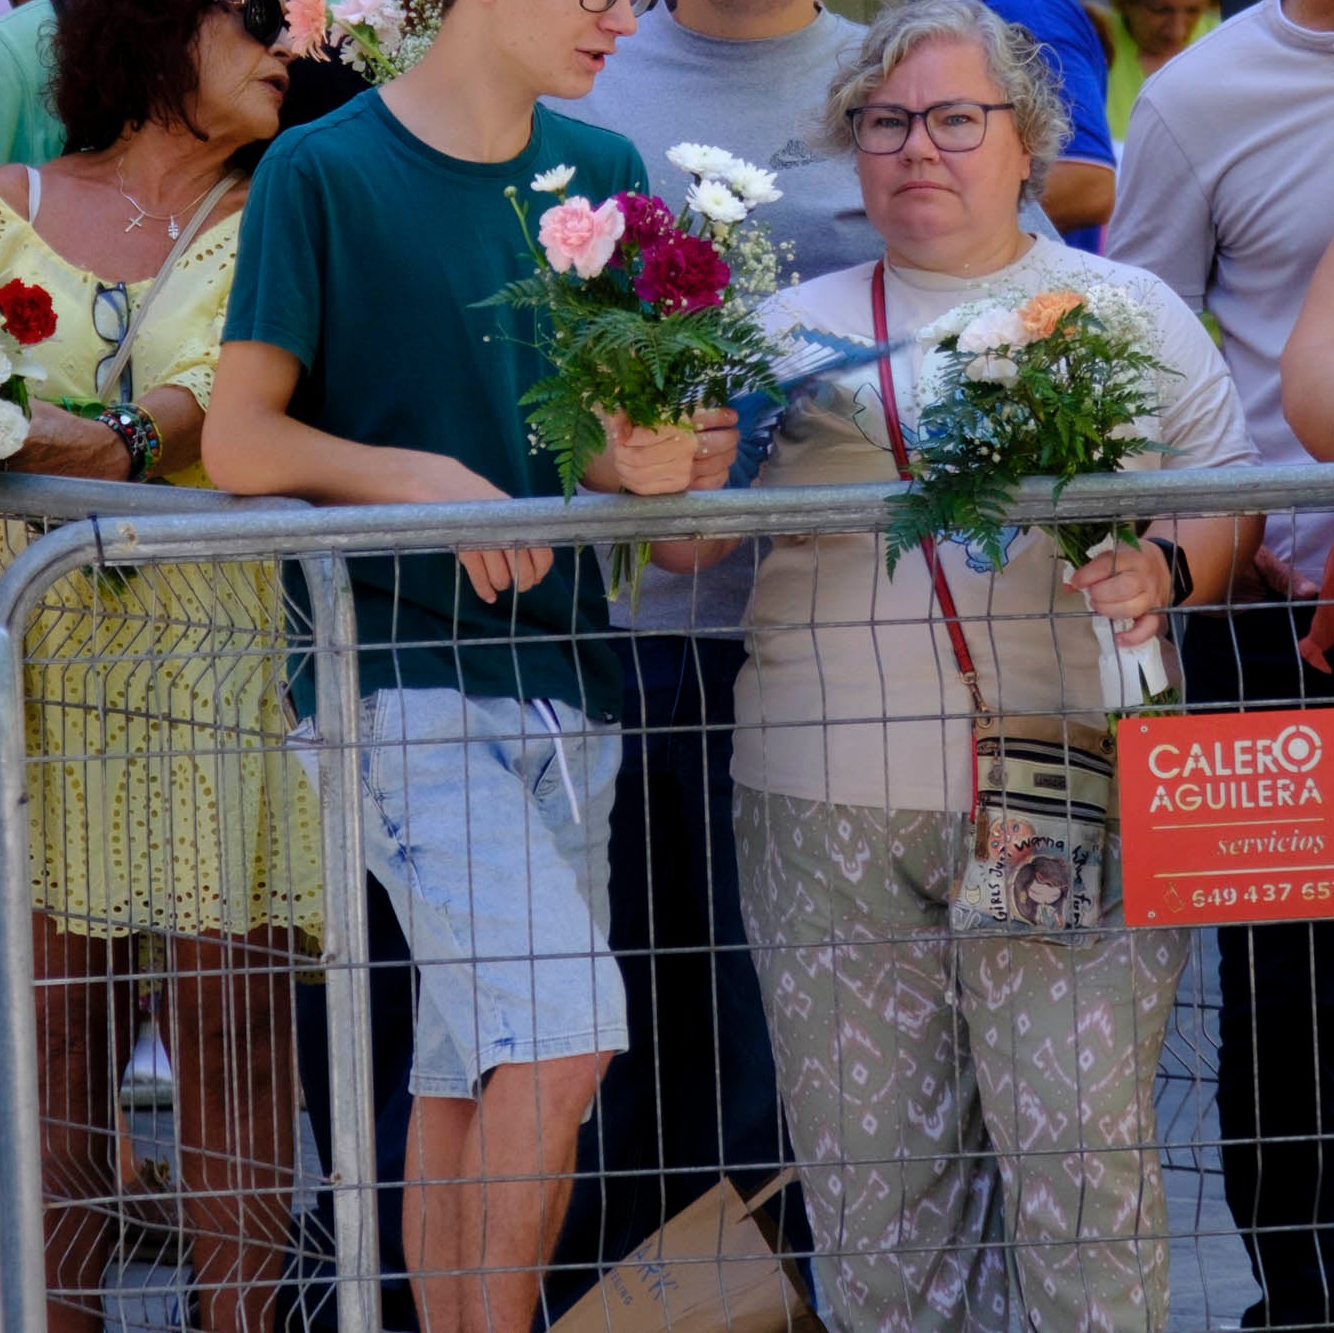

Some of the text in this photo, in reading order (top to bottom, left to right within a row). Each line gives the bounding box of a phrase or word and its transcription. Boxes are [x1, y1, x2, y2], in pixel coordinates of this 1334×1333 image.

[1148, 724, 1322, 779] CALERO
[1149, 777, 1323, 813] AGUILERA
[1216, 829, 1326, 855] servicios
[1191, 887, 1237, 908] 649
[1243, 883, 1291, 903] 437
